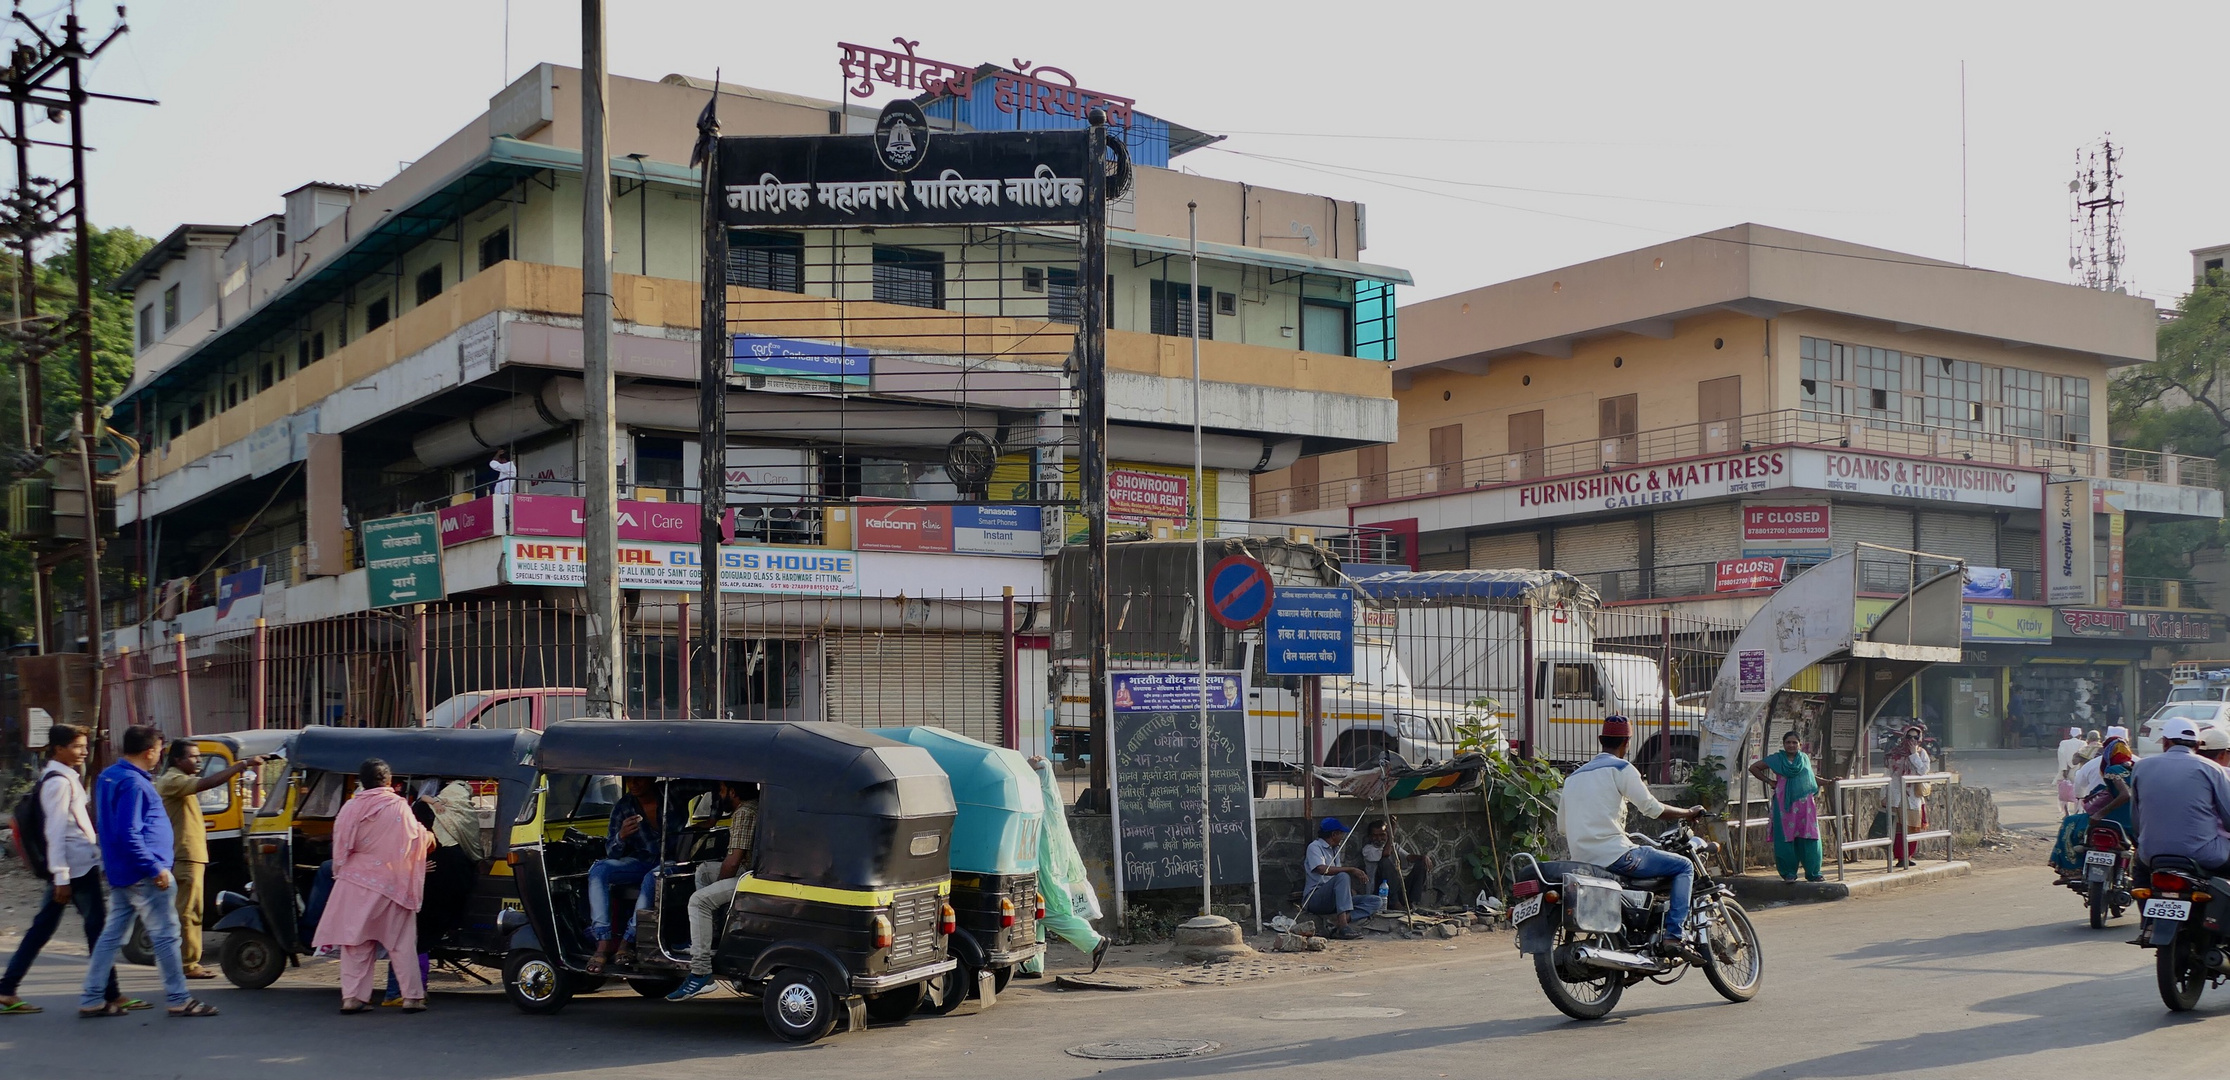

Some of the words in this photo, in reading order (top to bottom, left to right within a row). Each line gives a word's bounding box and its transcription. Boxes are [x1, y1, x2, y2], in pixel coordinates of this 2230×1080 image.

[726, 172, 810, 213] नाशिक
[817, 180, 909, 214] महानगर
[913, 169, 1000, 208] पालिका
[1005, 164, 1084, 212] नाशिक
[823, 354, 855, 366] Service
[763, 473, 788, 485] Care
[1520, 473, 1641, 507] FURNISHING
[1646, 470, 1660, 490] &
[1667, 453, 1784, 488] MATTRESS
[1826, 455, 1890, 482] FOAMS
[1894, 462, 1908, 483] &
[1912, 464, 2016, 493] FURNISHING
[1116, 475, 1178, 493] SHOWROOM
[1891, 483, 1958, 501] GALLERY
[1110, 489, 1143, 502] OFFICE
[1144, 491, 1157, 504] ON
[1160, 494, 1184, 506] RENT
[1605, 488, 1684, 509] GALLERY
[978, 506, 1017, 516] Panasonic
[1751, 512, 1764, 523] IF
[1768, 511, 1820, 523] CLOSED
[441, 517, 459, 533] AVA
[463, 513, 475, 528] Care
[652, 513, 683, 529] Care
[866, 518, 916, 531] Karbonn
[978, 517, 996, 526] Smart
[997, 518, 1017, 527] Phones
[983, 530, 1013, 541] Instant
[370, 556, 411, 570] वामनदादा
[516, 543, 662, 566] NATIAL
[670, 550, 760, 570] GLSS
[767, 554, 852, 573] HOUSE
[516, 572, 543, 580] SPECIALIST
[517, 562, 537, 571] WHOLE
[540, 563, 556, 571] SALE
[627, 567, 638, 575] ALL
[640, 568, 656, 577] KIND
[658, 568, 666, 577] OF
[668, 568, 687, 578] SAINT
[721, 571, 751, 580] ODIGUARD
[753, 572, 774, 581] GLASS
[782, 573, 813, 582] HARDWARE
[1722, 564, 1733, 575] IF
[1735, 561, 1774, 574] CLOSED
[392, 572, 416, 588] मार्ग
[2016, 618, 2042, 634] Kitply
[2060, 609, 2128, 635] कृष्णा
[2148, 614, 2209, 640] Krishna
[1278, 626, 1295, 640] शंकर
[1129, 675, 1162, 685] भारतीय
[2088, 856, 2113, 865] 9193
[1514, 903, 1539, 922] 3528
[2147, 907, 2185, 919] 8833
